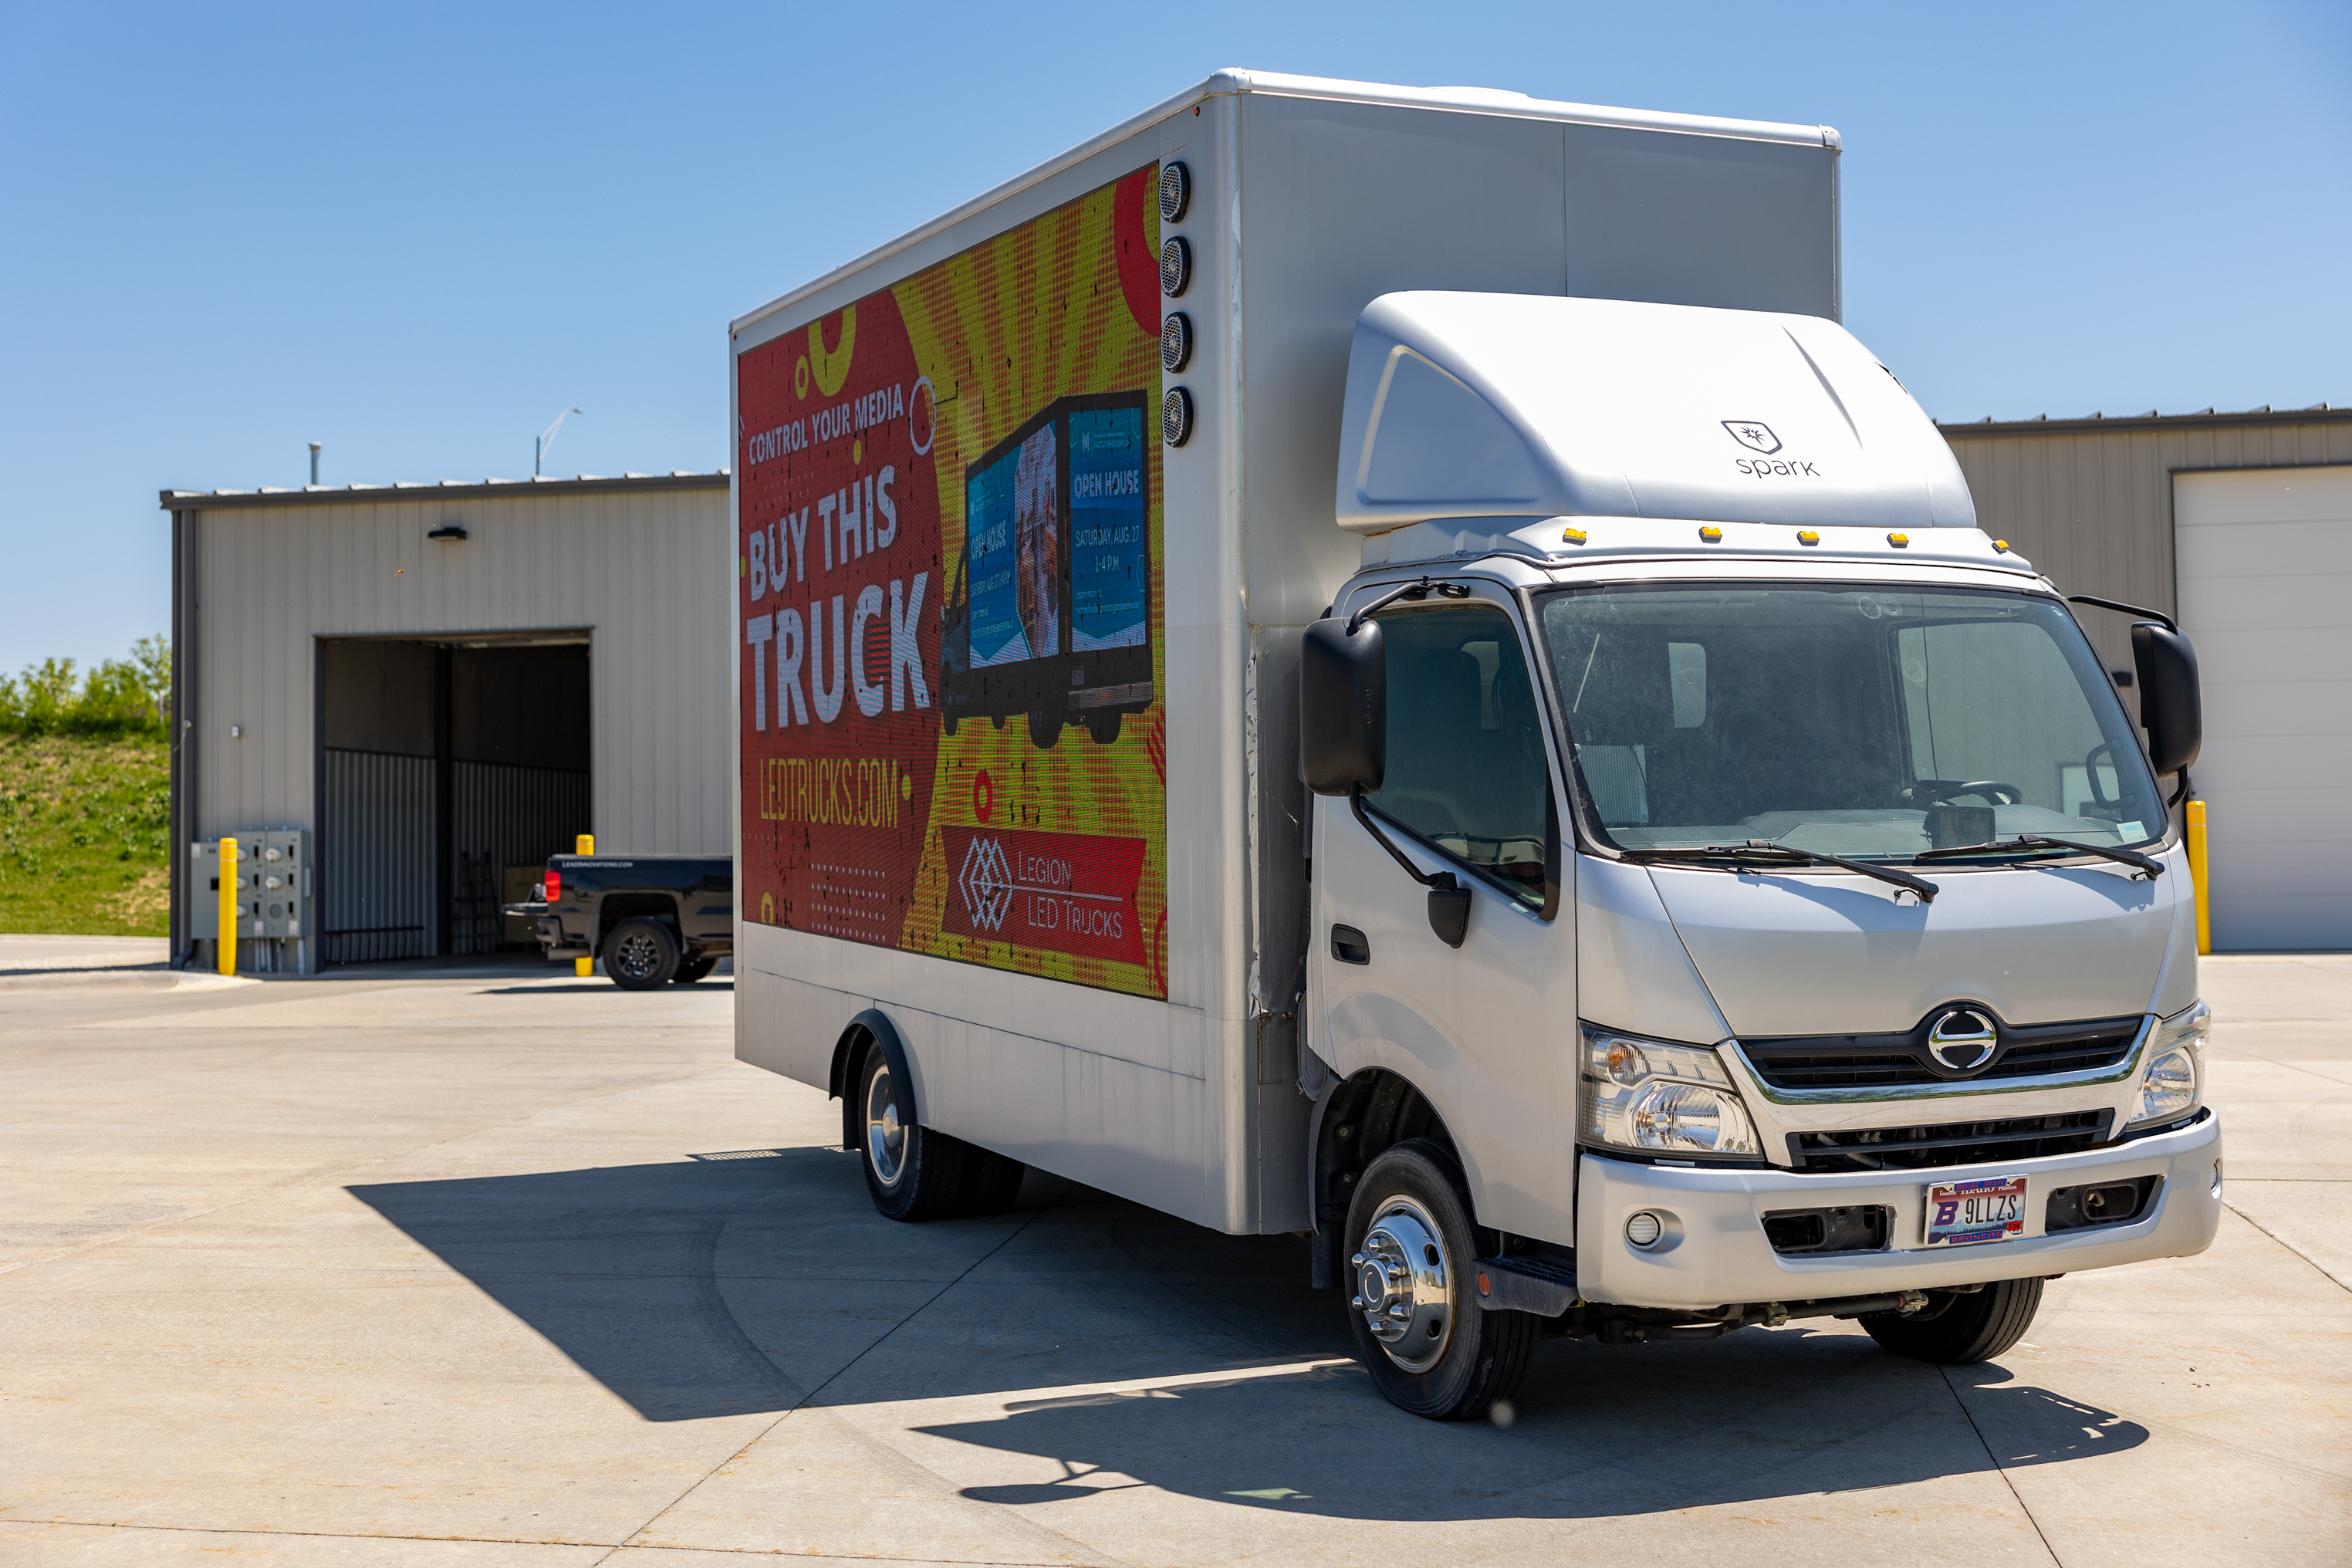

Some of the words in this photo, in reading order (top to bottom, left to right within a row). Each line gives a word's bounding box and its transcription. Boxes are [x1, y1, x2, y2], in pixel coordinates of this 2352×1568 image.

[749, 418, 808, 465] CONTROL
[812, 403, 851, 444] YOUR
[854, 384, 904, 431] MEDIA
[1074, 473, 1102, 499] OPEN
[1105, 469, 1139, 496] HOUSE
[1735, 458, 1820, 479] spark
[749, 505, 809, 602] BUY
[818, 465, 897, 572] THIS
[971, 532, 986, 562] OPEN
[987, 519, 1006, 555] HOUSE
[1113, 526, 1131, 544] AUG.
[1131, 525, 1140, 542] 27
[747, 571, 931, 732] TRUCK
[760, 757, 897, 829] LEDTRUCKS.COM
[1029, 896, 1059, 929] LED
[1956, 1182, 1980, 1191] BOISE
[1983, 1179, 2006, 1188] STATE
[1965, 1195, 2017, 1225] 9LLZS
[1951, 1232, 2002, 1242] BRONCOS
